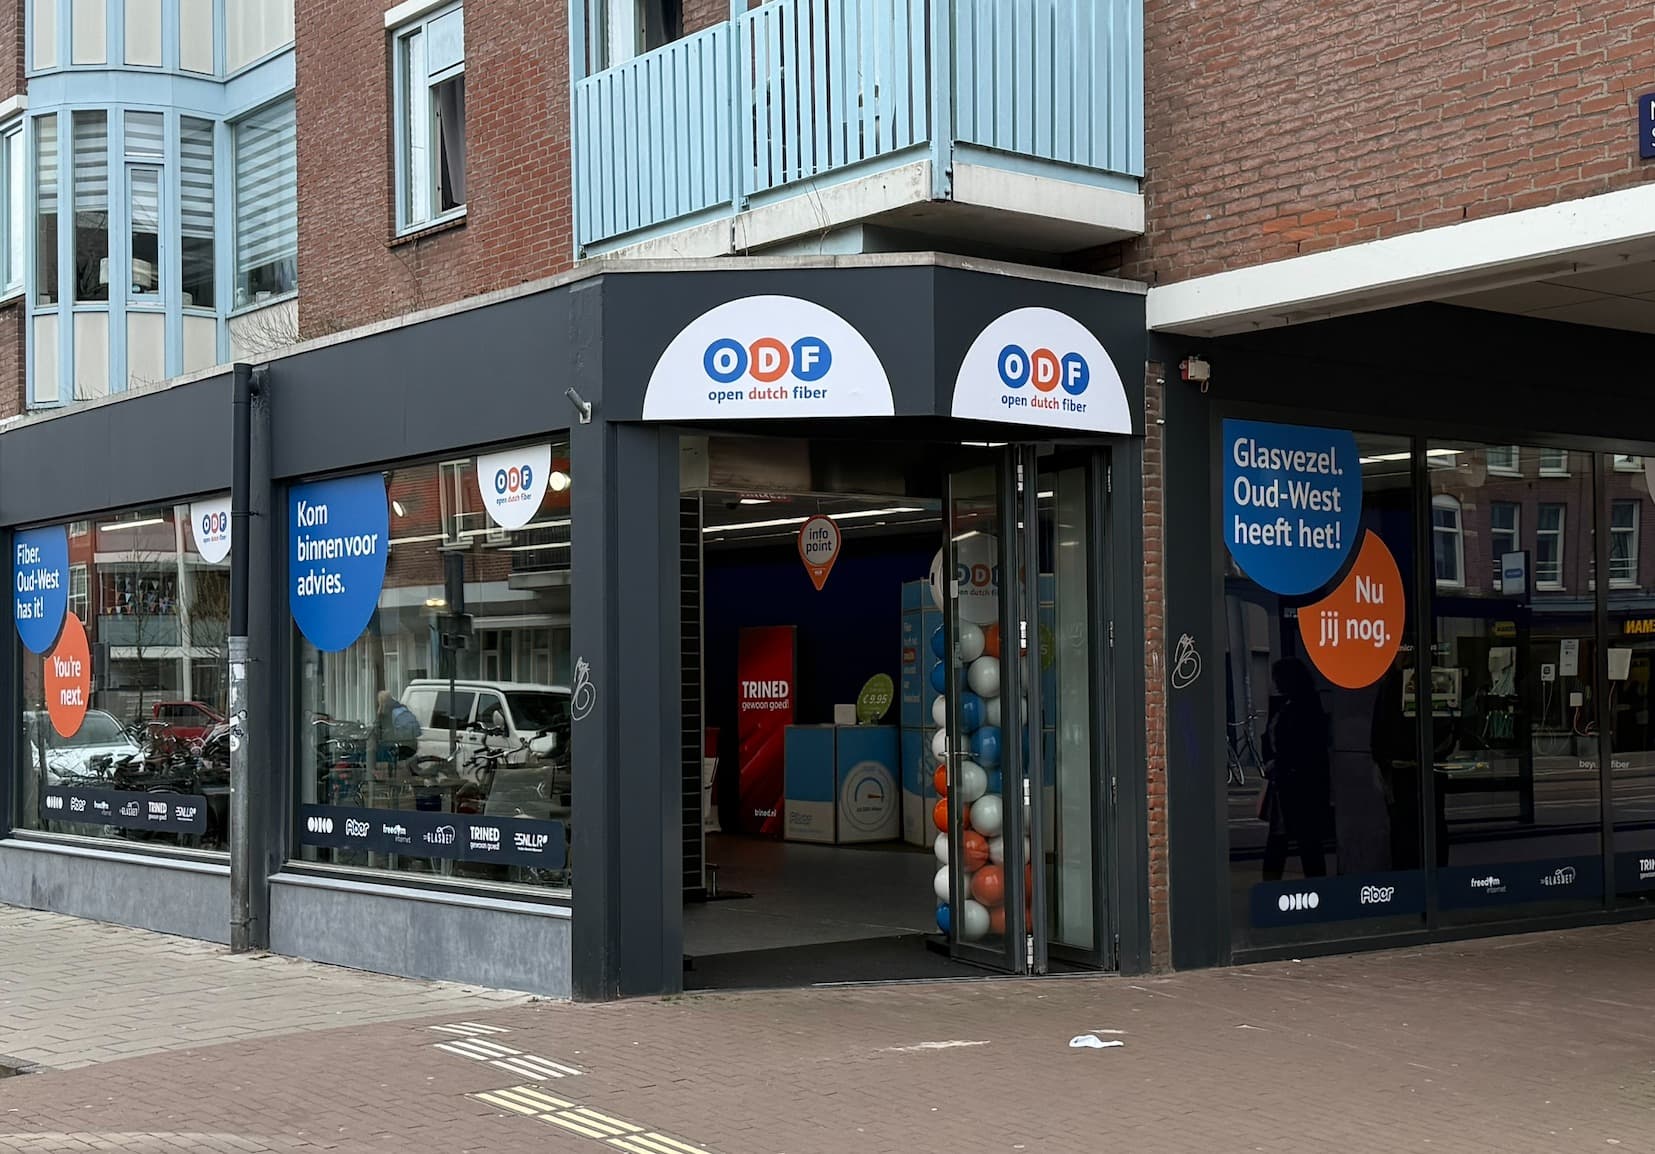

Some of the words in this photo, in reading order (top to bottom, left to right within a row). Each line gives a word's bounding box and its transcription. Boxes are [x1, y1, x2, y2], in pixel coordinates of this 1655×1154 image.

[707, 340, 828, 380] ODF
[1001, 348, 1086, 392] ODF
[708, 390, 744, 404] open
[748, 386, 788, 400] dutch
[792, 386, 828, 399] fiber
[1001, 395, 1028, 409] open
[1031, 394, 1060, 410] dutch
[1062, 398, 1088, 413] fiber
[1233, 437, 1343, 476] Glasvezel.
[495, 467, 532, 492] ODF
[1233, 475, 1342, 512] Oud-West
[203, 512, 227, 534] ODF
[297, 500, 328, 528] Kom
[809, 527, 829, 540] info
[1234, 514, 1293, 547] heeft
[1299, 518, 1341, 550] het!
[16, 543, 41, 565] Fiber.
[297, 534, 343, 562] binnen
[344, 533, 378, 557] voor
[806, 541, 833, 555] point
[16, 567, 60, 592] Oud-West
[297, 567, 346, 596] advies.
[1355, 574, 1384, 605] Nu
[17, 597, 32, 619] has
[33, 596, 44, 618] it!
[1319, 610, 1339, 647] jij
[1346, 618, 1391, 648] nog.
[53, 655, 81, 678] You're
[60, 685, 84, 706] next.
[742, 680, 789, 699] TRINED
[742, 701, 769, 711] gewoon
[469, 826, 500, 842] TRINED
